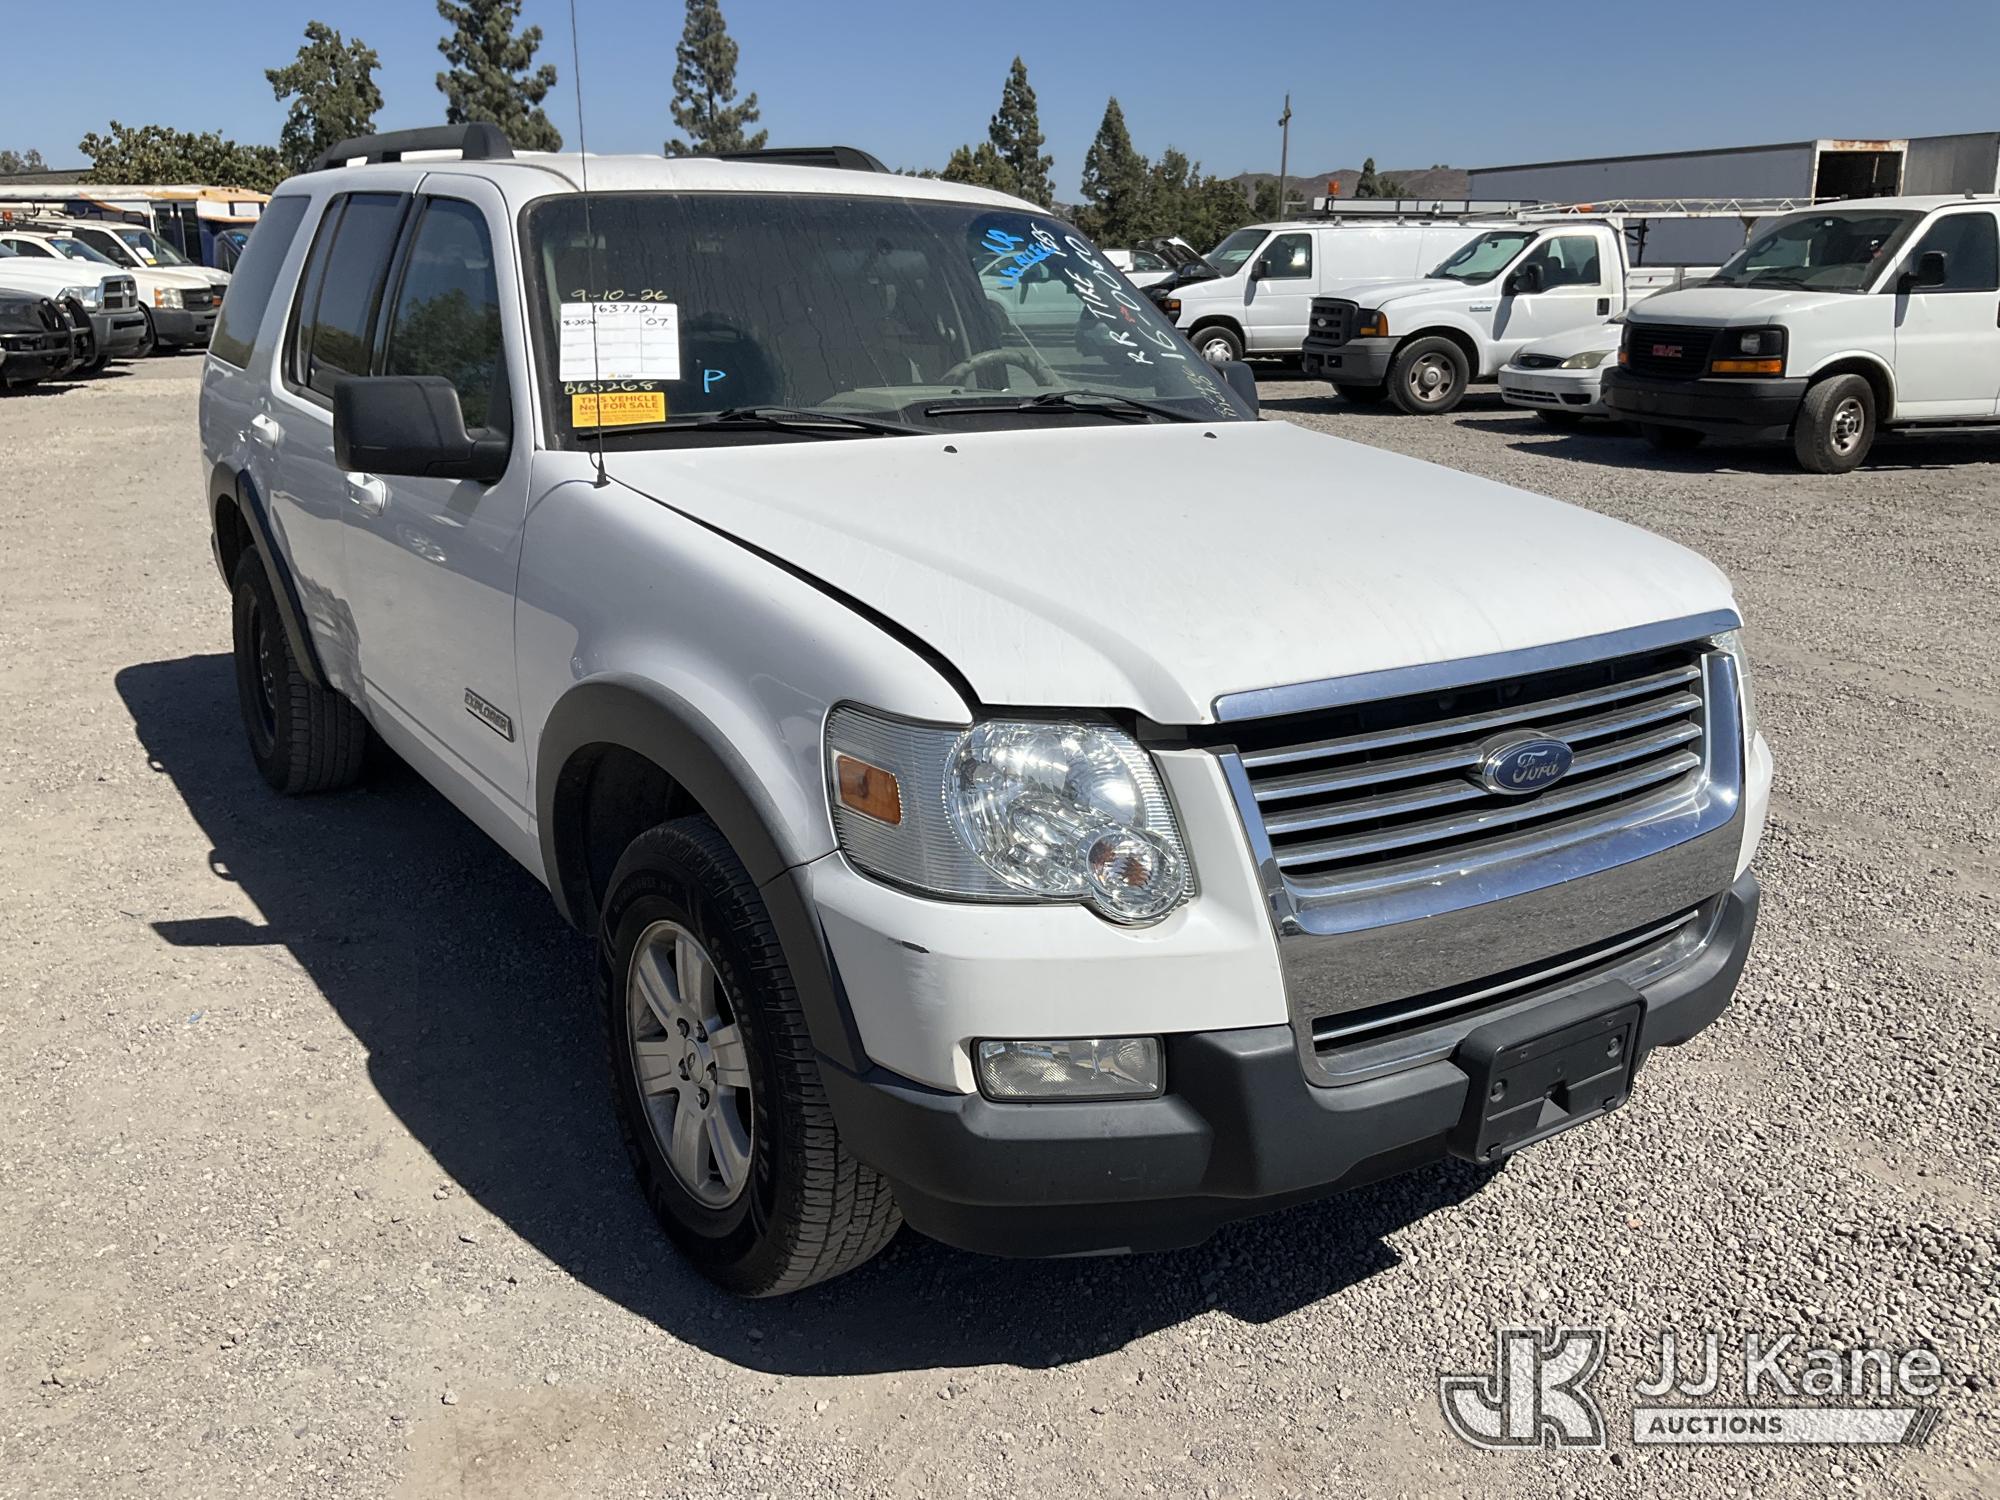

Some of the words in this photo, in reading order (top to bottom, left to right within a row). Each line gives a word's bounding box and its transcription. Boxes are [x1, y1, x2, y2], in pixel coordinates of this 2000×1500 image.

[646, 318, 669, 327] 07
[1652, 344, 1683, 358] GMC
[703, 369, 727, 393] P
[581, 395, 607, 404] THS
[609, 395, 658, 403] VEHICLE
[603, 402, 627, 410] FOR
[629, 401, 659, 409] SALE
[1512, 750, 1560, 784] Ford
